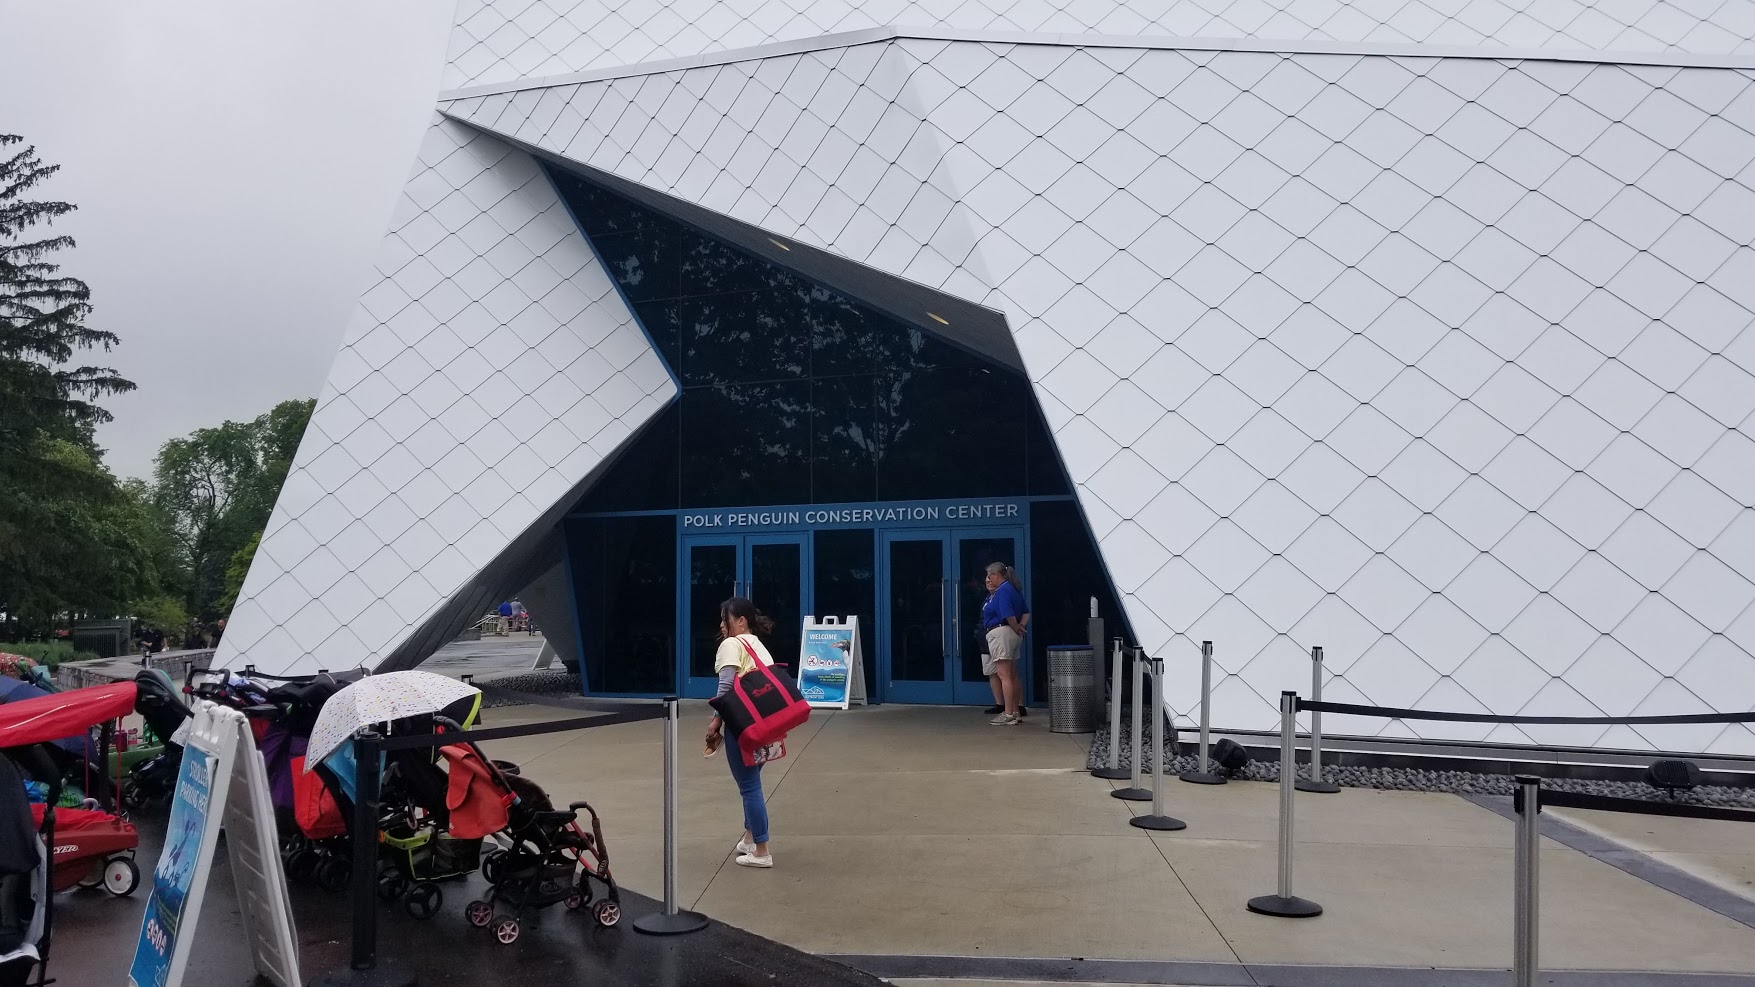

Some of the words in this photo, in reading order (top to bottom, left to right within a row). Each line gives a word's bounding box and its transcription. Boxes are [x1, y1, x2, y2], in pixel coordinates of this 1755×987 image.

[684, 514, 723, 527] POLK
[728, 511, 799, 526] PENGUIN
[805, 506, 939, 523] CONSERVATION
[945, 503, 1018, 519] CENTER
